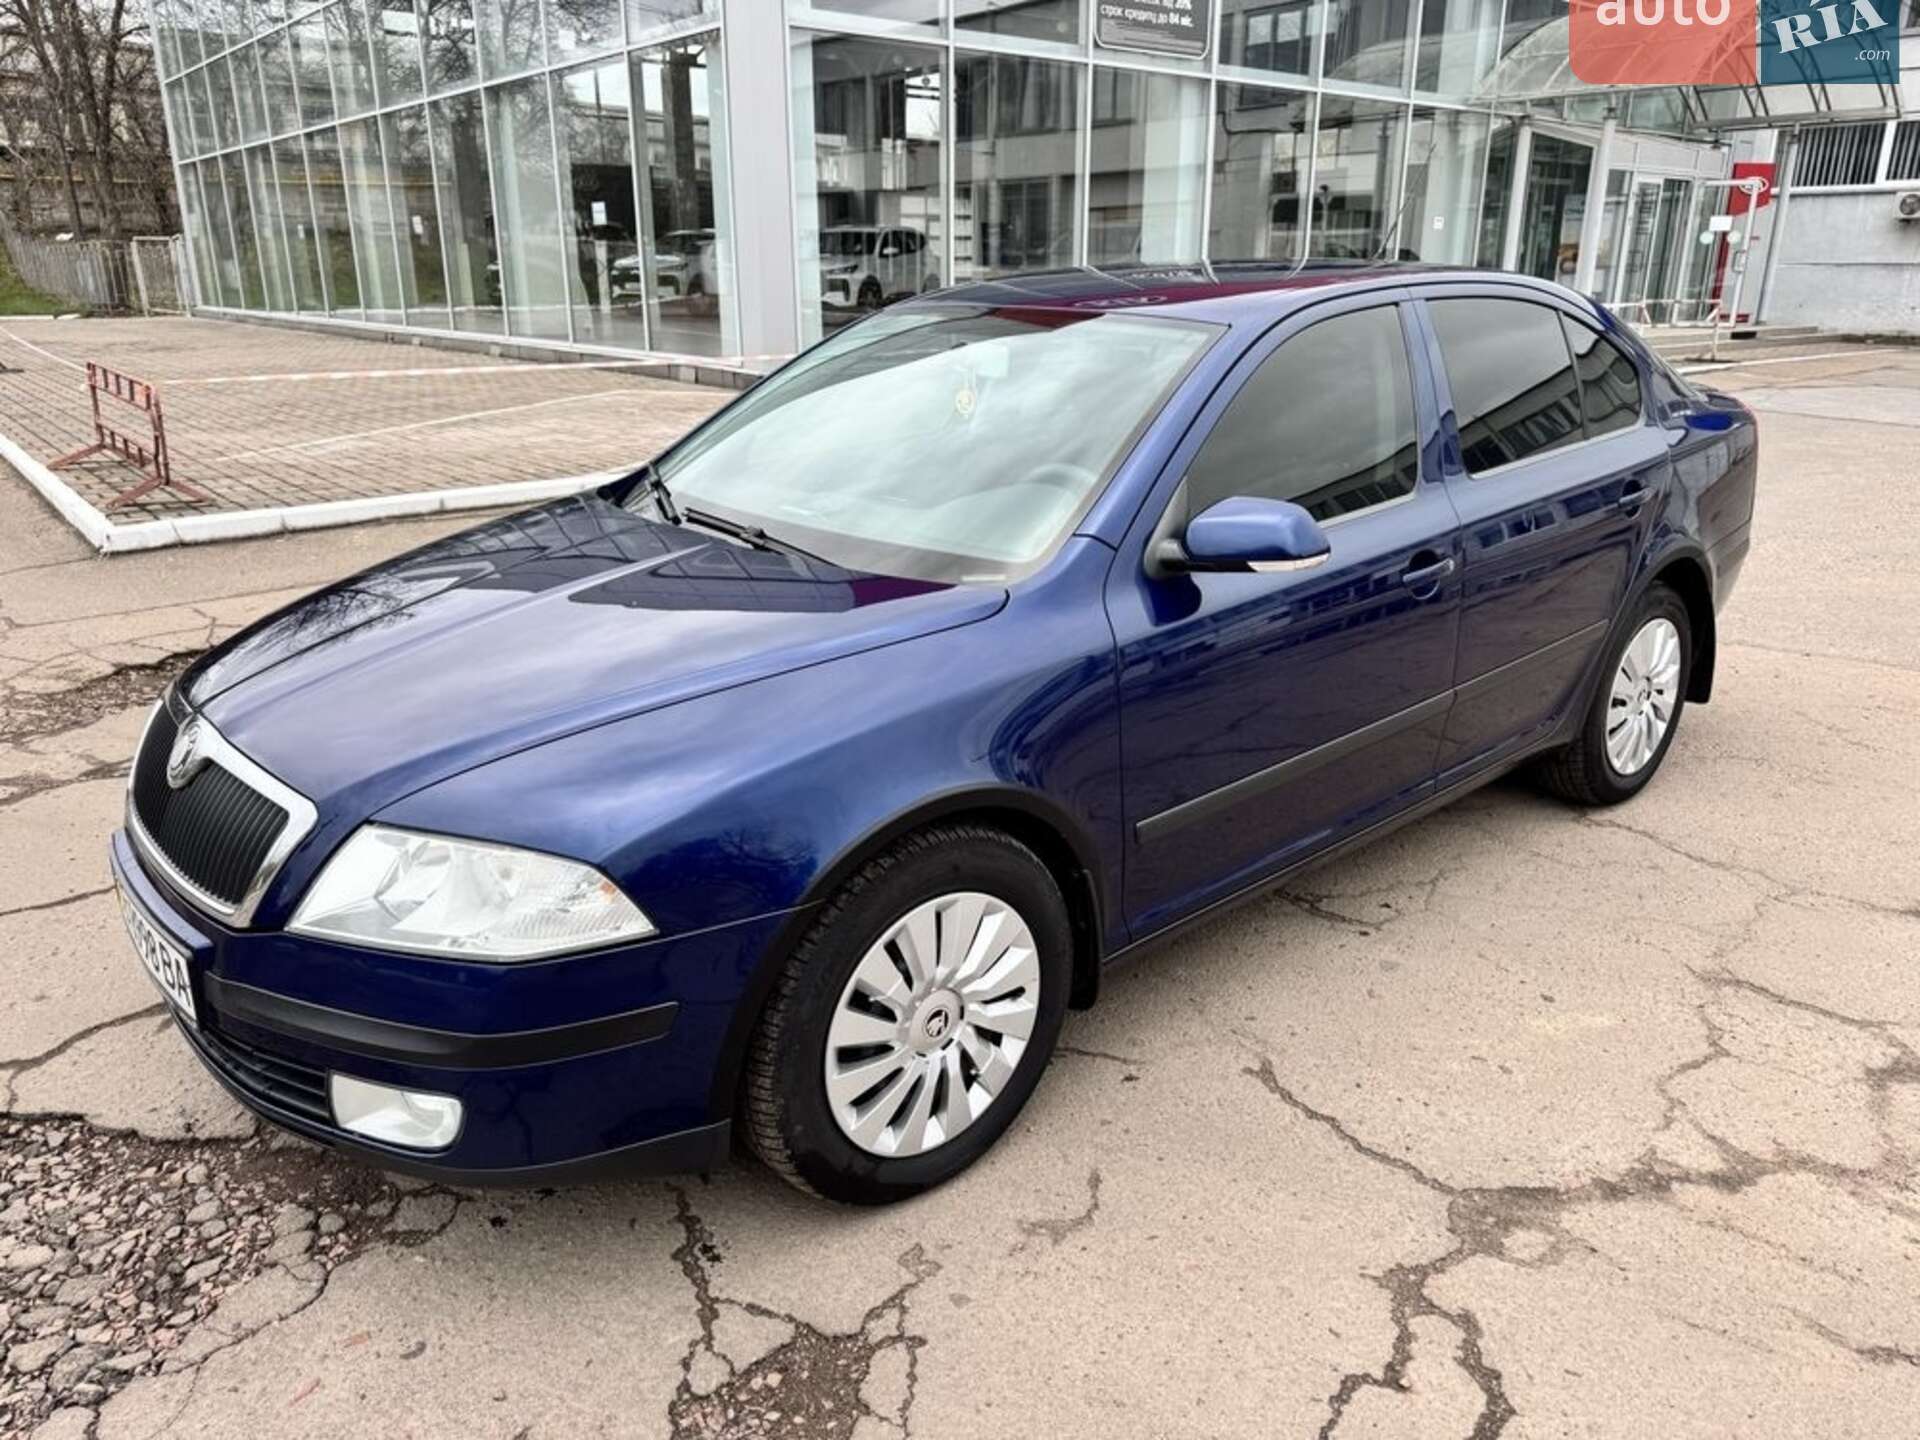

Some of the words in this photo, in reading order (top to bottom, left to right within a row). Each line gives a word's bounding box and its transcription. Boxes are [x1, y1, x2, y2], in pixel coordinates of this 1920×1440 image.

[1100, 4, 1123, 17] строк
[1125, 8, 1157, 24] кредиту
[1157, 12, 1168, 24] до
